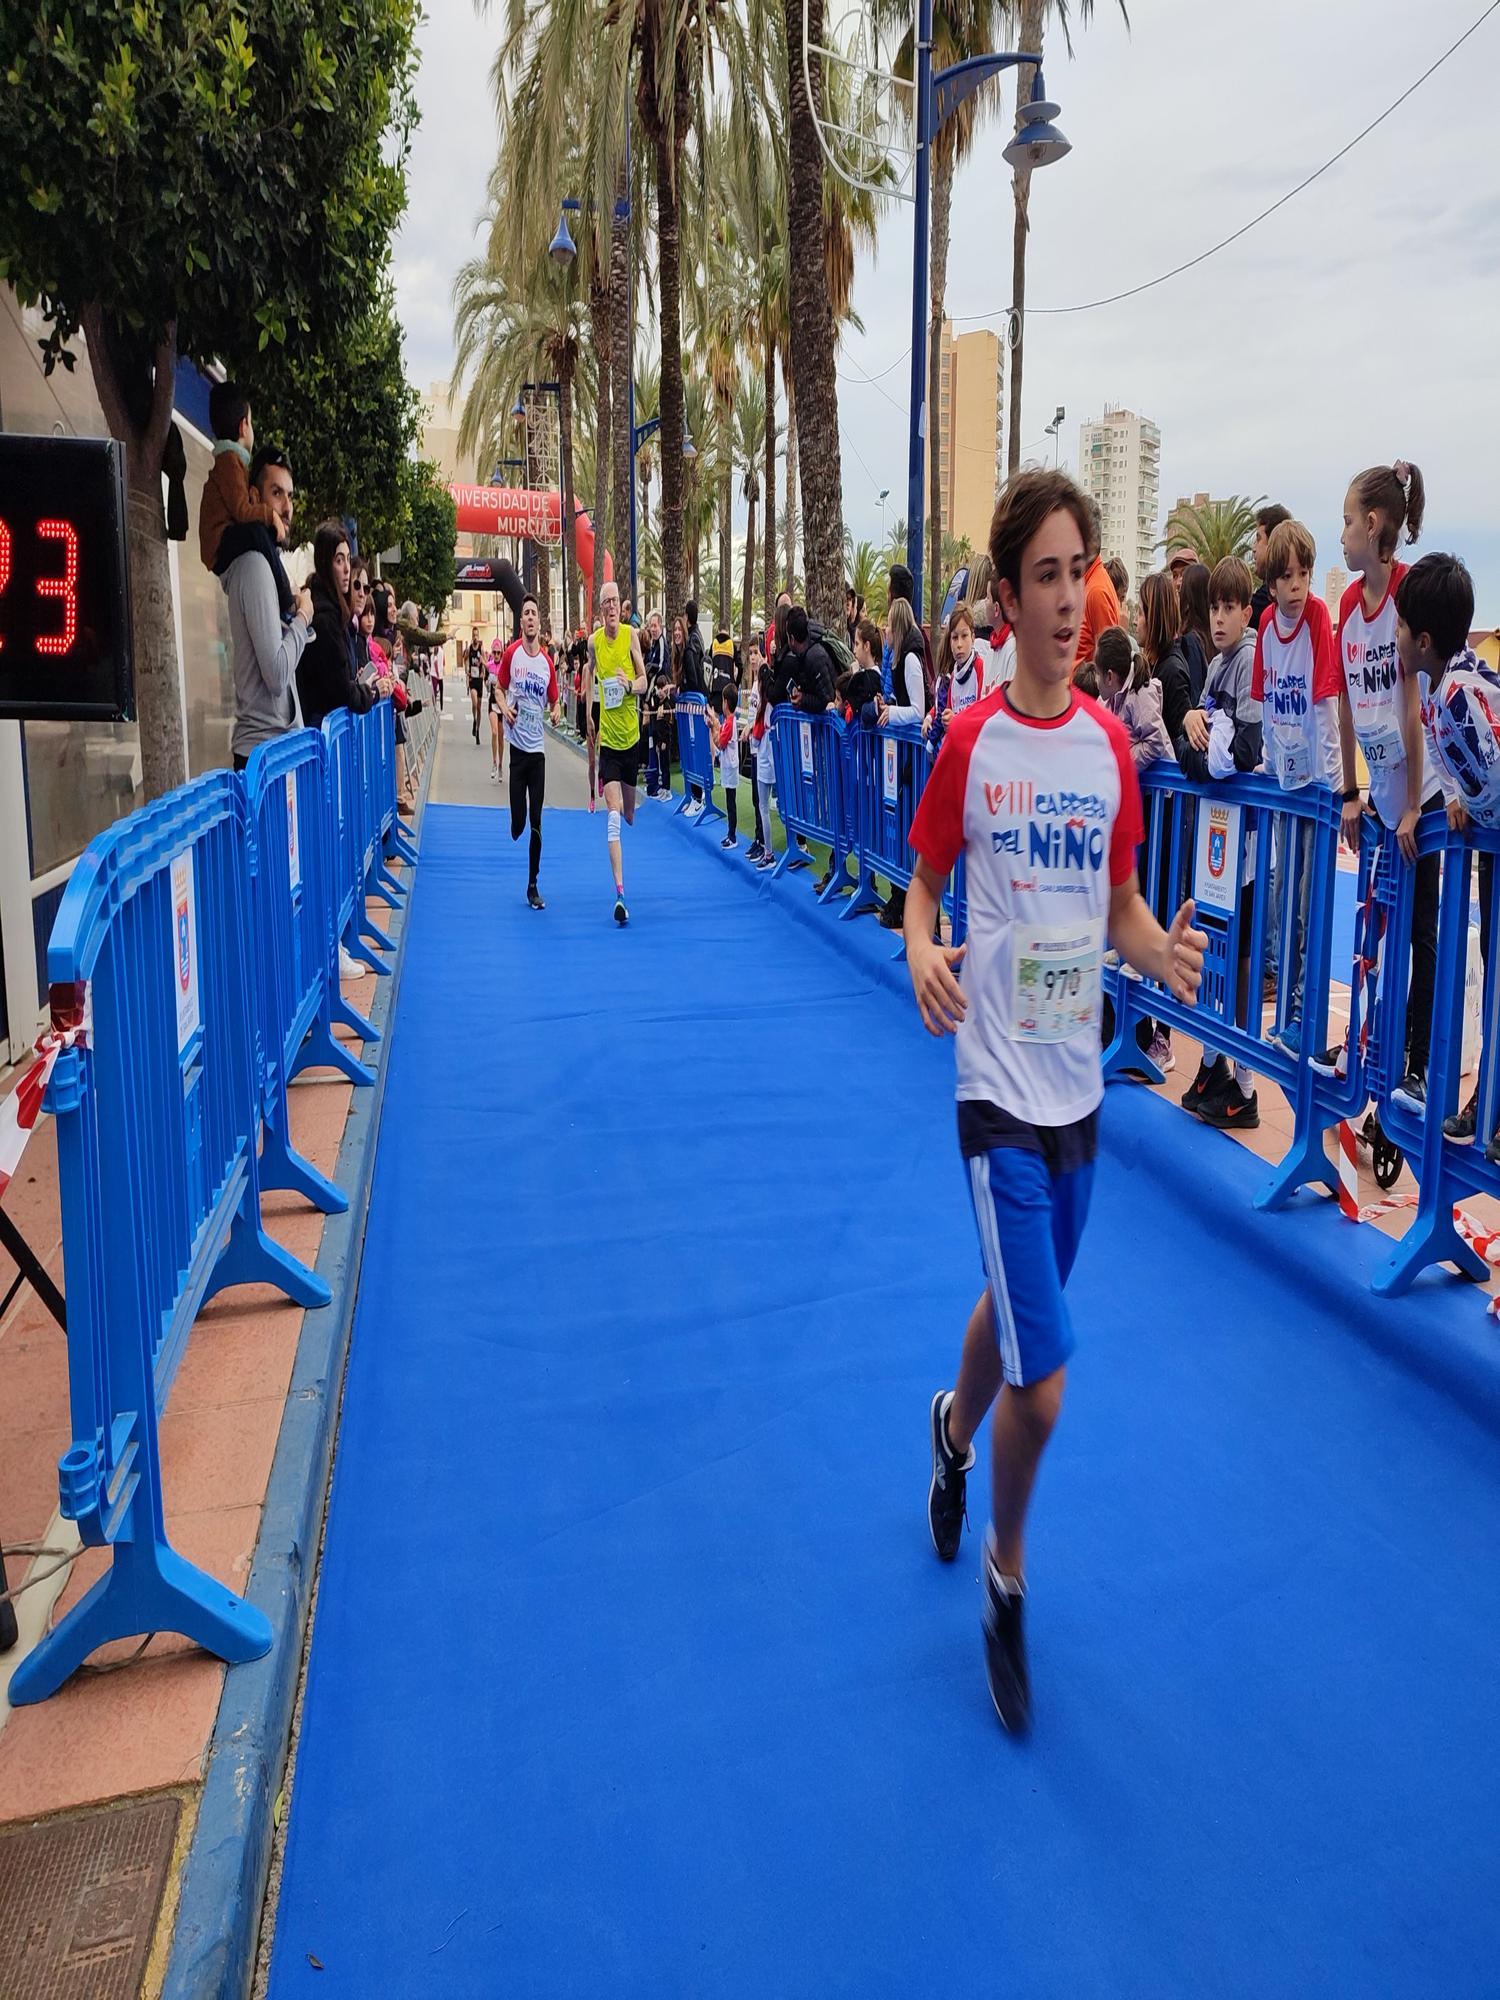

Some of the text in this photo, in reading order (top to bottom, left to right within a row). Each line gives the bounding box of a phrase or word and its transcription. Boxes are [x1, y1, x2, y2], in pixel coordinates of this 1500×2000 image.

[450, 487, 550, 512] NIVERSIDAD DE
[497, 515, 547, 536] MURCIA
[1363, 744, 1387, 761] 602
[991, 828, 1025, 856] DEL
[1043, 966, 1082, 1001] 970
